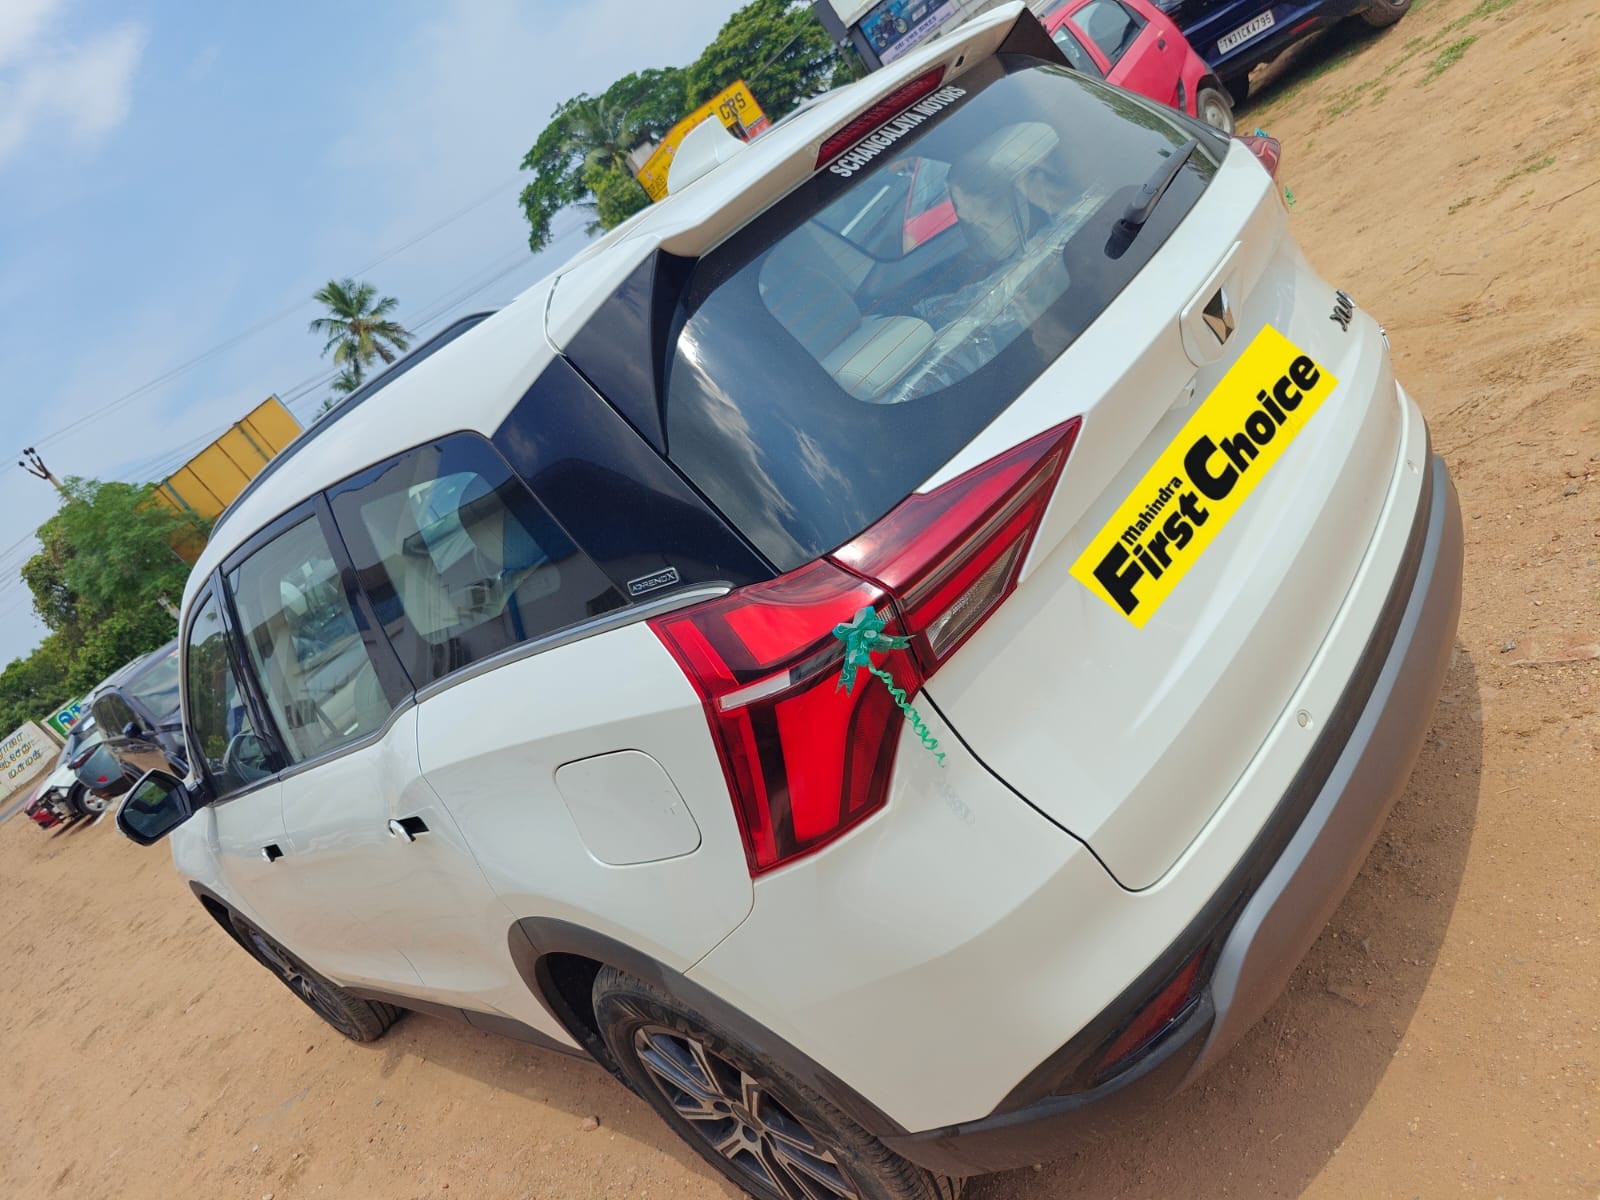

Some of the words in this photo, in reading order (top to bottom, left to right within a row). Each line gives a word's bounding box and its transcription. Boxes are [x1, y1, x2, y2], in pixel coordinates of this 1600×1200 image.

[1223, 13, 1272, 49] TN31CK4795
[829, 112, 927, 177] SCHANGALAYA
[912, 86, 967, 117] MOTORS
[631, 570, 677, 593] ADRENOX
